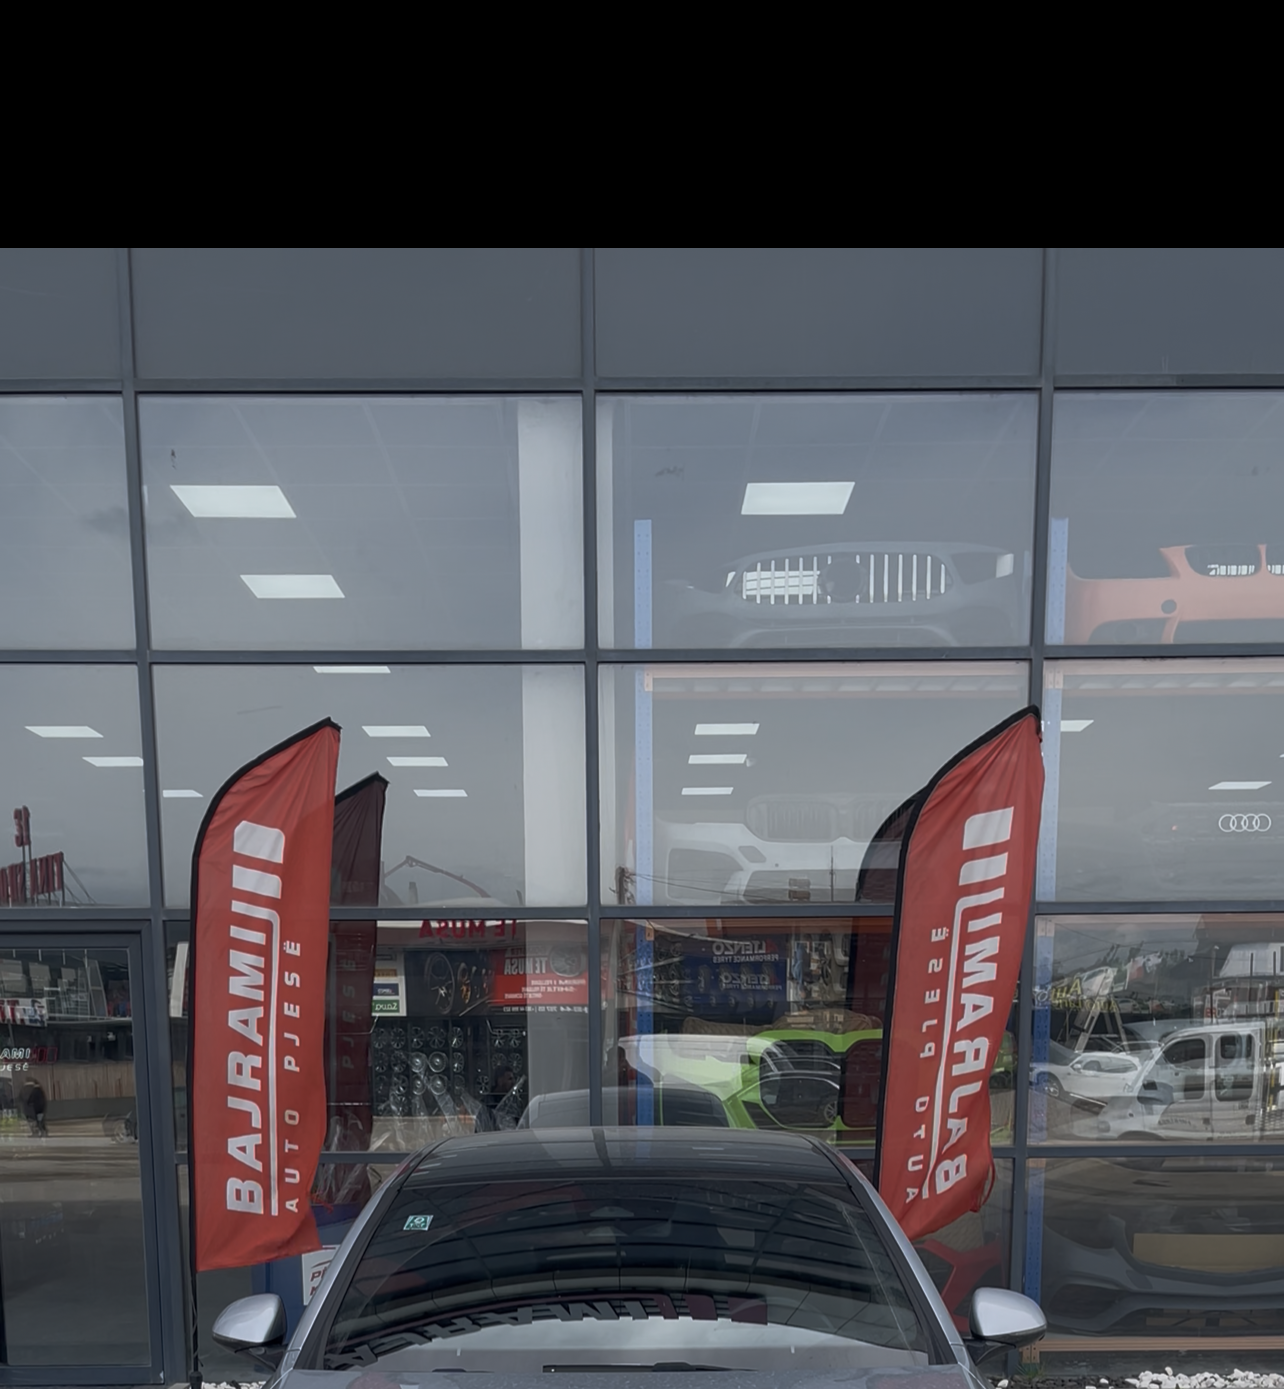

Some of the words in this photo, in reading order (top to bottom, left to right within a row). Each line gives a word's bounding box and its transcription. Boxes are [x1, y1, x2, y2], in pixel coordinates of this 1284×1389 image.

[227, 925, 267, 1215] BAJRAMI
[282, 940, 302, 1073] PJESË
[284, 1108, 301, 1213] AUTO
